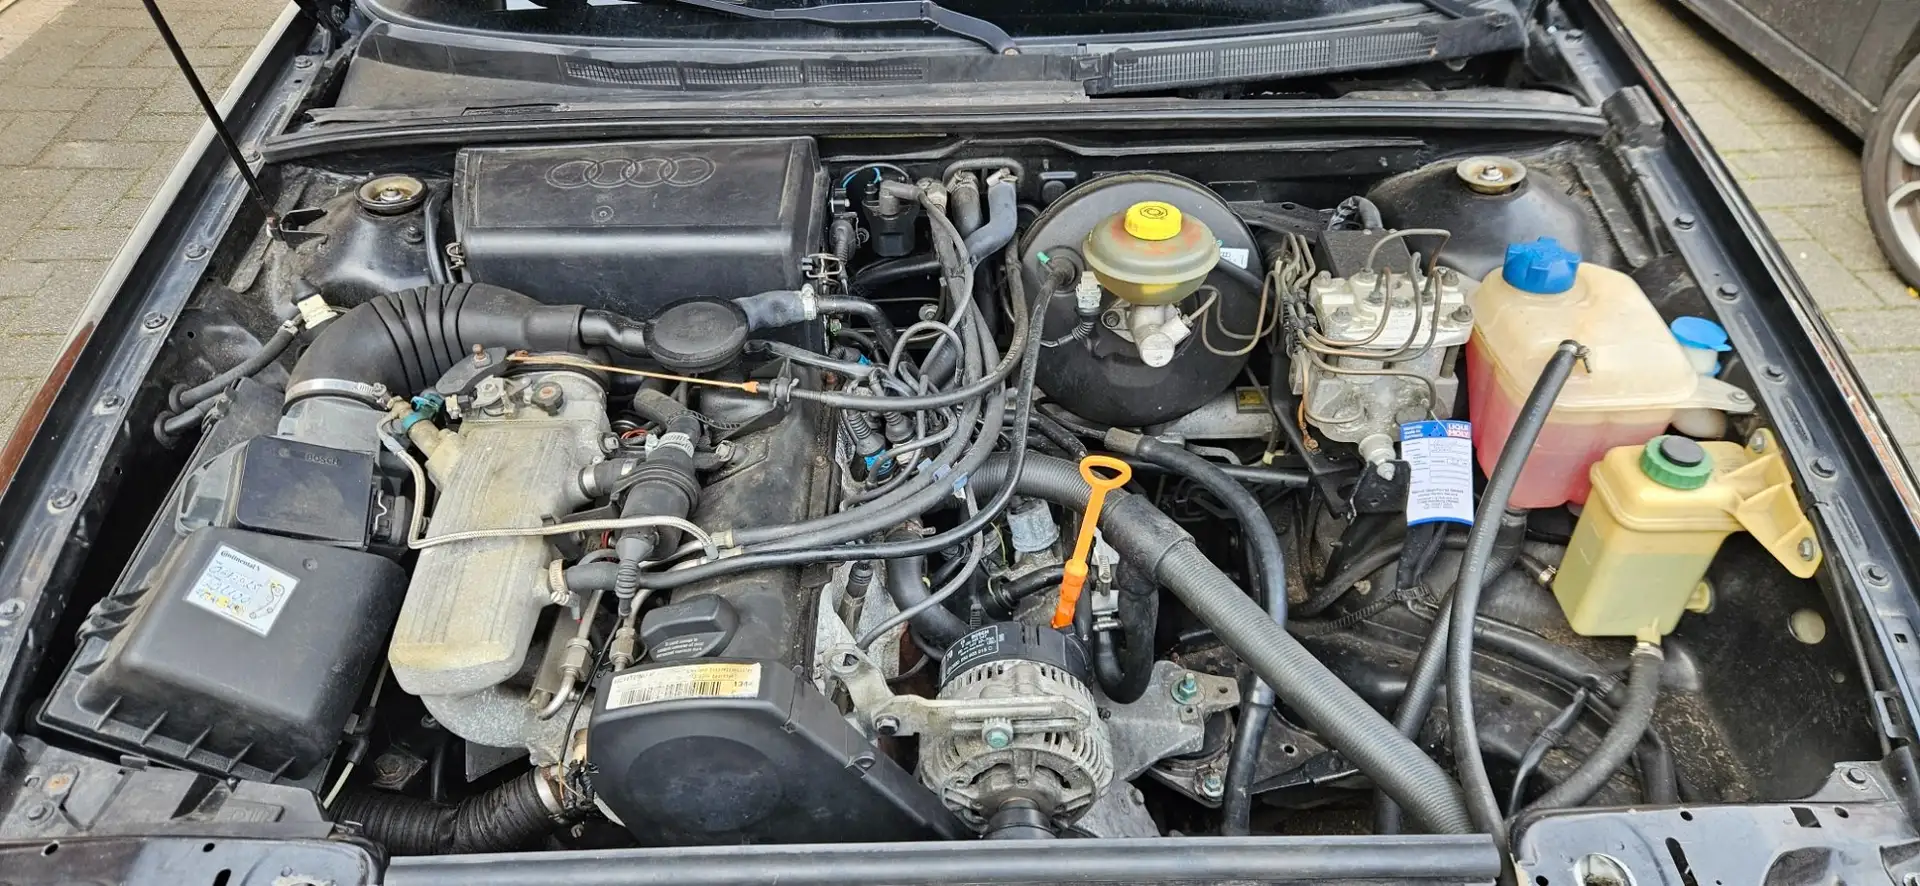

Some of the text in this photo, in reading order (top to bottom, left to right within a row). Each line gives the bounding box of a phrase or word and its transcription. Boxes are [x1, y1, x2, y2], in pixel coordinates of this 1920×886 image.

[1448, 430, 1469, 438] MOLY
[305, 452, 341, 467] BOSCH
[220, 550, 257, 570] Continental
